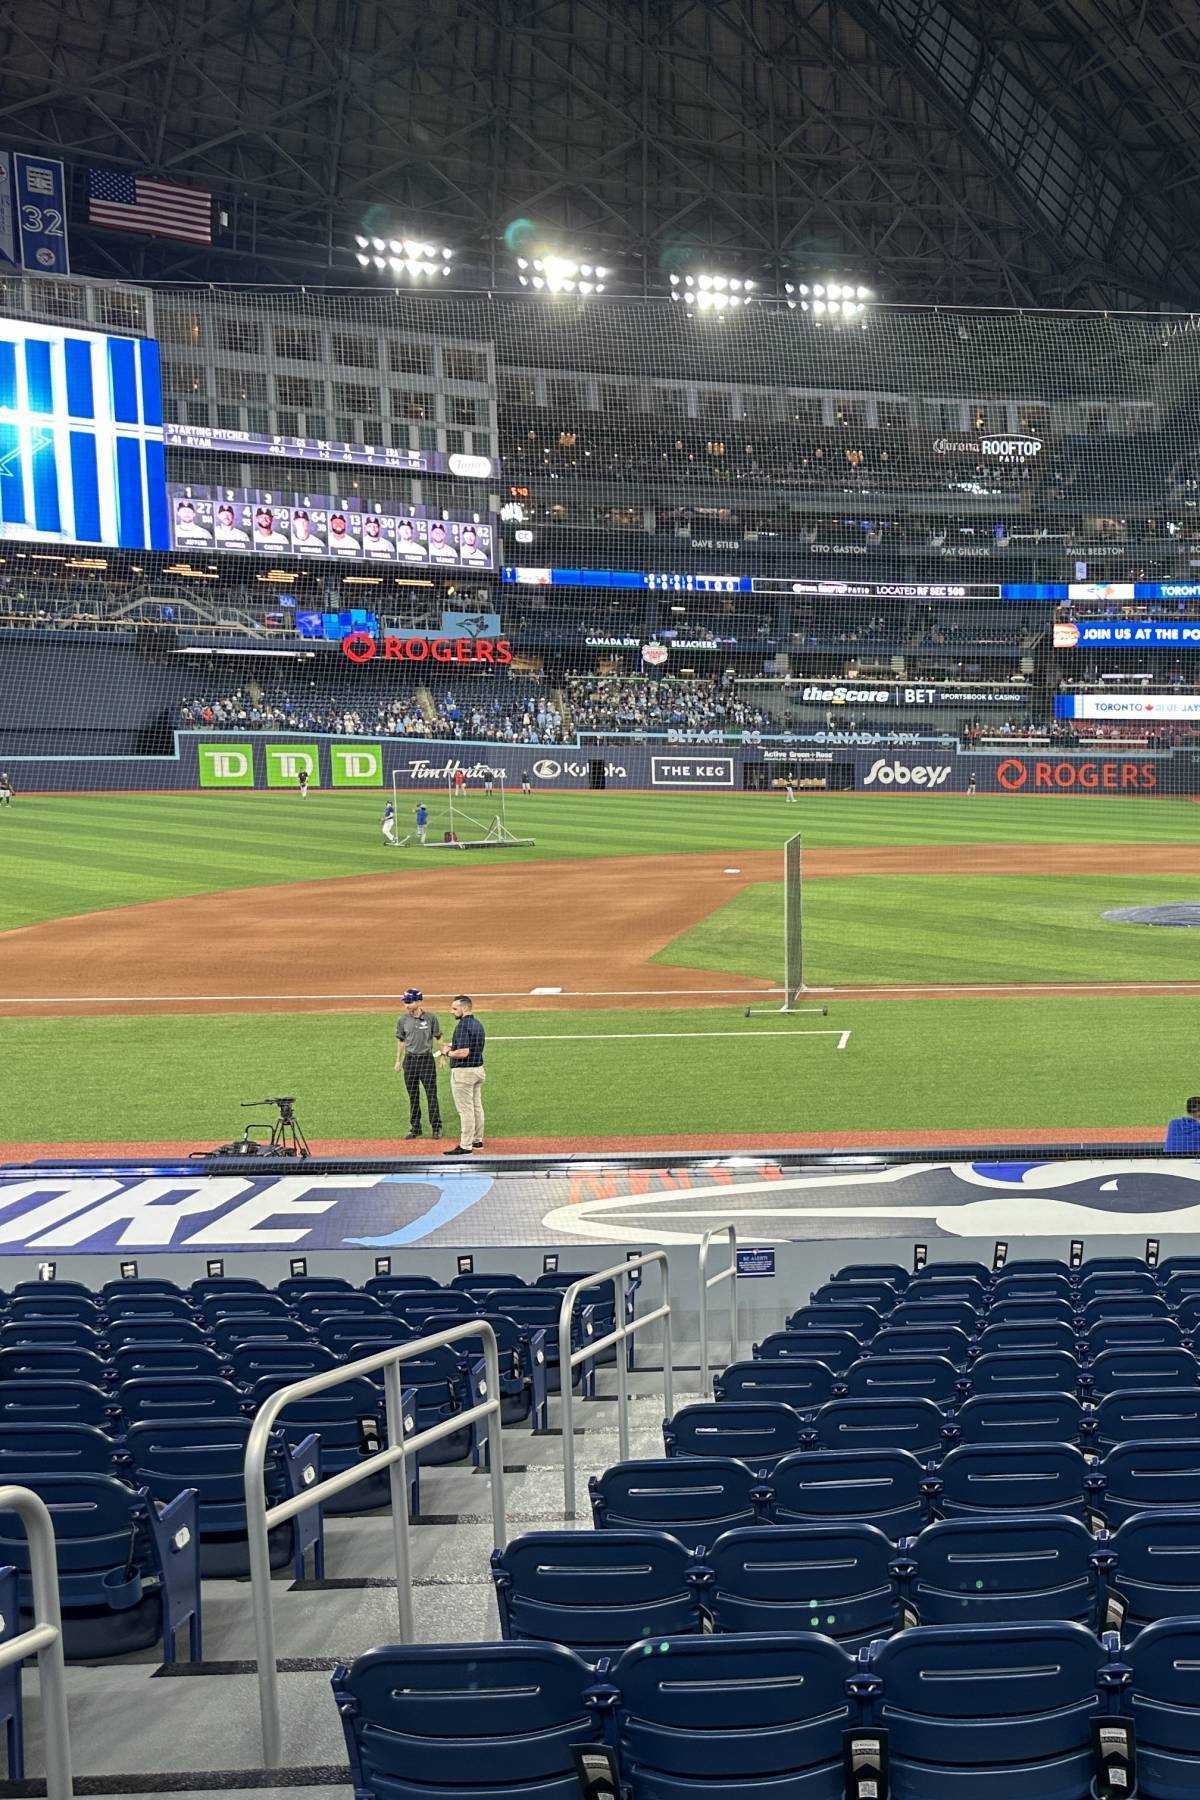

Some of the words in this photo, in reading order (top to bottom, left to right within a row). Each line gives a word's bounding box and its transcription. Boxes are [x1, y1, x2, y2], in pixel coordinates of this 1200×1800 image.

[22, 205, 63, 236] 32
[168, 423, 212, 438] STARTING
[212, 429, 250, 441] PITCHER
[187, 436, 211, 448] RYAN
[933, 439, 979, 455] Corona
[982, 440, 1041, 456] ROOFTOP
[185, 487, 191, 498] 1
[226, 490, 234, 501] 2
[264, 493, 272, 504] 3
[197, 502, 212, 514] 27
[242, 506, 251, 517] 4
[274, 509, 289, 520] 50
[311, 512, 326, 523] 64
[350, 515, 360, 526] 13
[381, 517, 394, 529] 30
[416, 521, 426, 532] 12
[692, 539, 712, 548] DAVE
[716, 541, 739, 549] STIEB
[811, 544, 830, 553] CITO
[833, 545, 866, 554] GASTON
[942, 548, 955, 556] PAT
[958, 548, 989, 556] GILLICK
[1066, 548, 1086, 556] PAUL
[1088, 547, 1124, 556] BEESTON
[876, 586, 916, 595] LOCATED
[917, 586, 928, 596] RF
[930, 587, 946, 596] SEC
[1083, 628, 1111, 640] JOIN
[1115, 629, 1131, 640] US
[1135, 629, 1152, 640] AT
[1155, 629, 1179, 640] THE
[585, 638, 622, 646] CANADA
[623, 638, 641, 646] DRY
[671, 640, 717, 649] BLEACHERS
[385, 637, 513, 664] ROGERS
[802, 686, 889, 704] theScore
[904, 688, 936, 703] BET
[941, 693, 987, 701] SPORTSBOOK
[988, 693, 993, 701] &
[1095, 702, 1143, 712] TORONTO
[764, 750, 787, 758] Active
[205, 752, 248, 778] TD
[272, 752, 313, 778] TD
[336, 752, 377, 777] TD
[408, 760, 439, 779] Tim
[661, 765, 691, 777] THE
[696, 765, 725, 777] KEG
[863, 758, 951, 788] Sobeys
[1035, 763, 1157, 788] ROGERS
